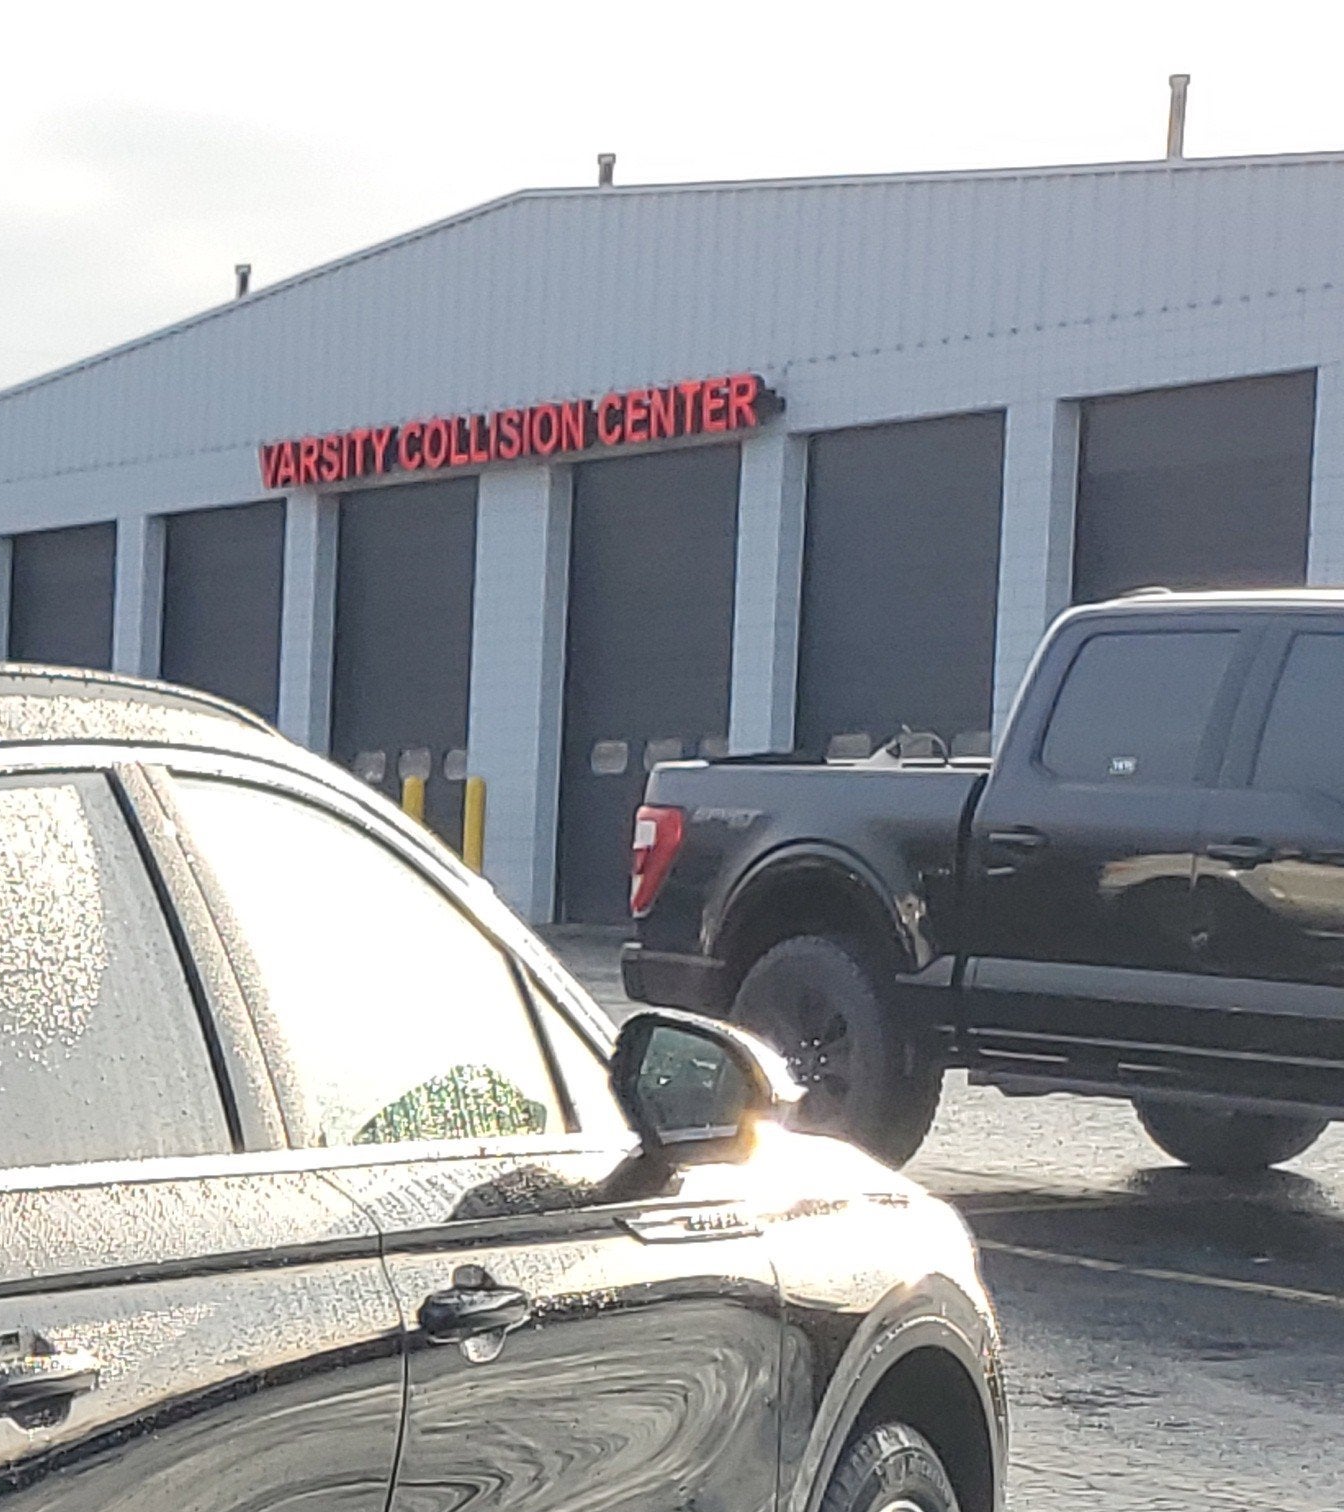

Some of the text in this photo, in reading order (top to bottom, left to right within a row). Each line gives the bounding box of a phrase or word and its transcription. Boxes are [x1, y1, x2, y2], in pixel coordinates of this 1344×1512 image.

[259, 372, 760, 490] VARSITY COLLISION CENTER
